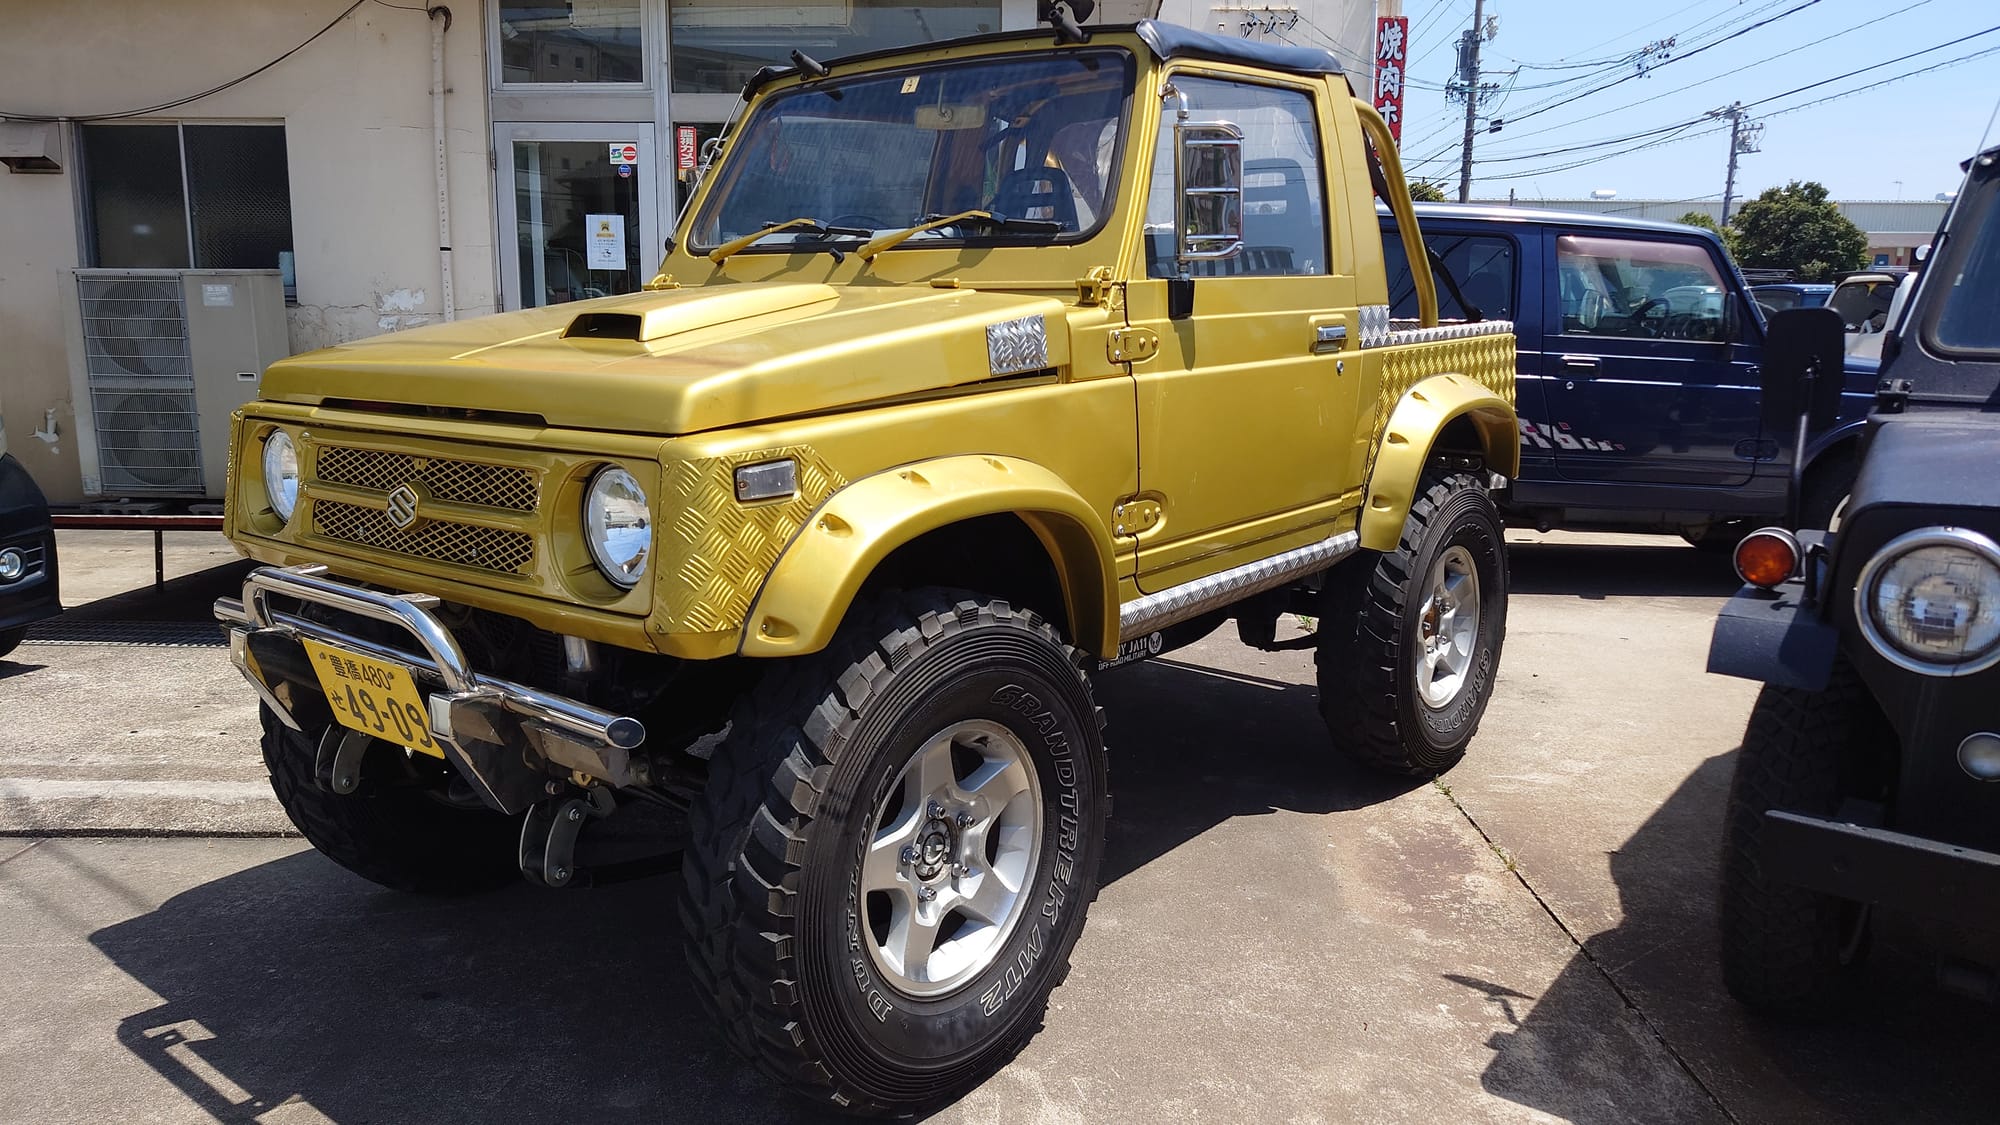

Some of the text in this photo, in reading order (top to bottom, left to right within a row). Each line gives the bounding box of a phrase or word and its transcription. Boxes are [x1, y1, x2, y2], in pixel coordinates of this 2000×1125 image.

[1378, 21, 1404, 125] 焼肉ホ
[1129, 637, 1147, 653] JA11
[344, 684, 433, 749] 49-09
[981, 683, 1080, 1017] GRANDTREK MT2
